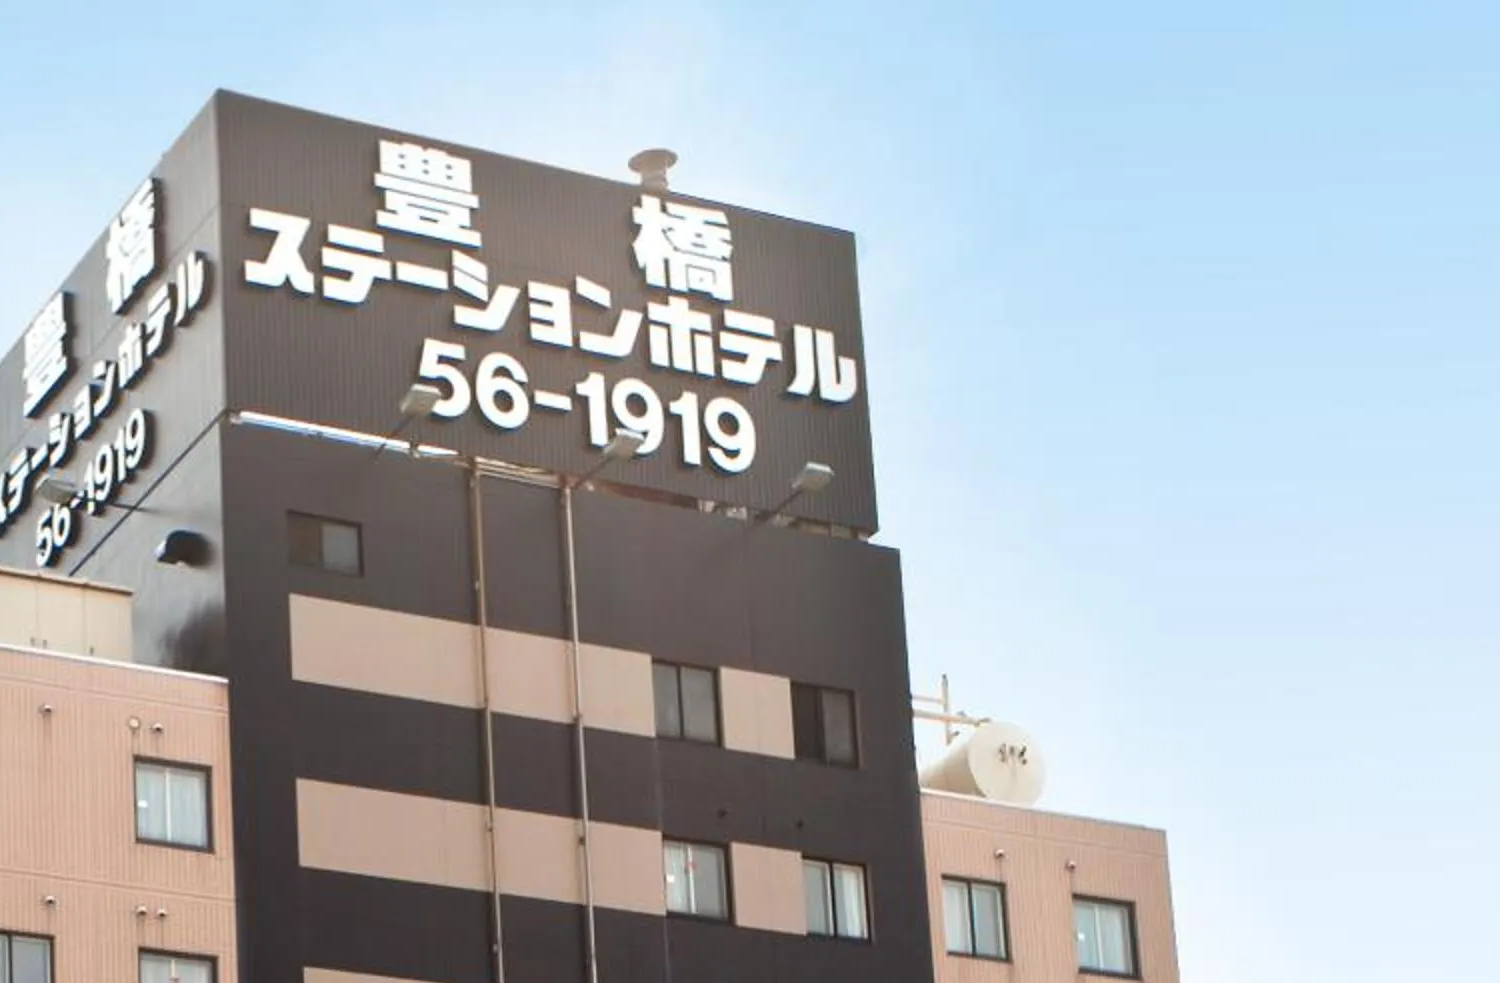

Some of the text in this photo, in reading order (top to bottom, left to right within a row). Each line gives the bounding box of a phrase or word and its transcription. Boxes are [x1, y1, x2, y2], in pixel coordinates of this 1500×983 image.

[243, 206, 857, 403] ステーションホテル
[418, 337, 758, 474] 56-1919
